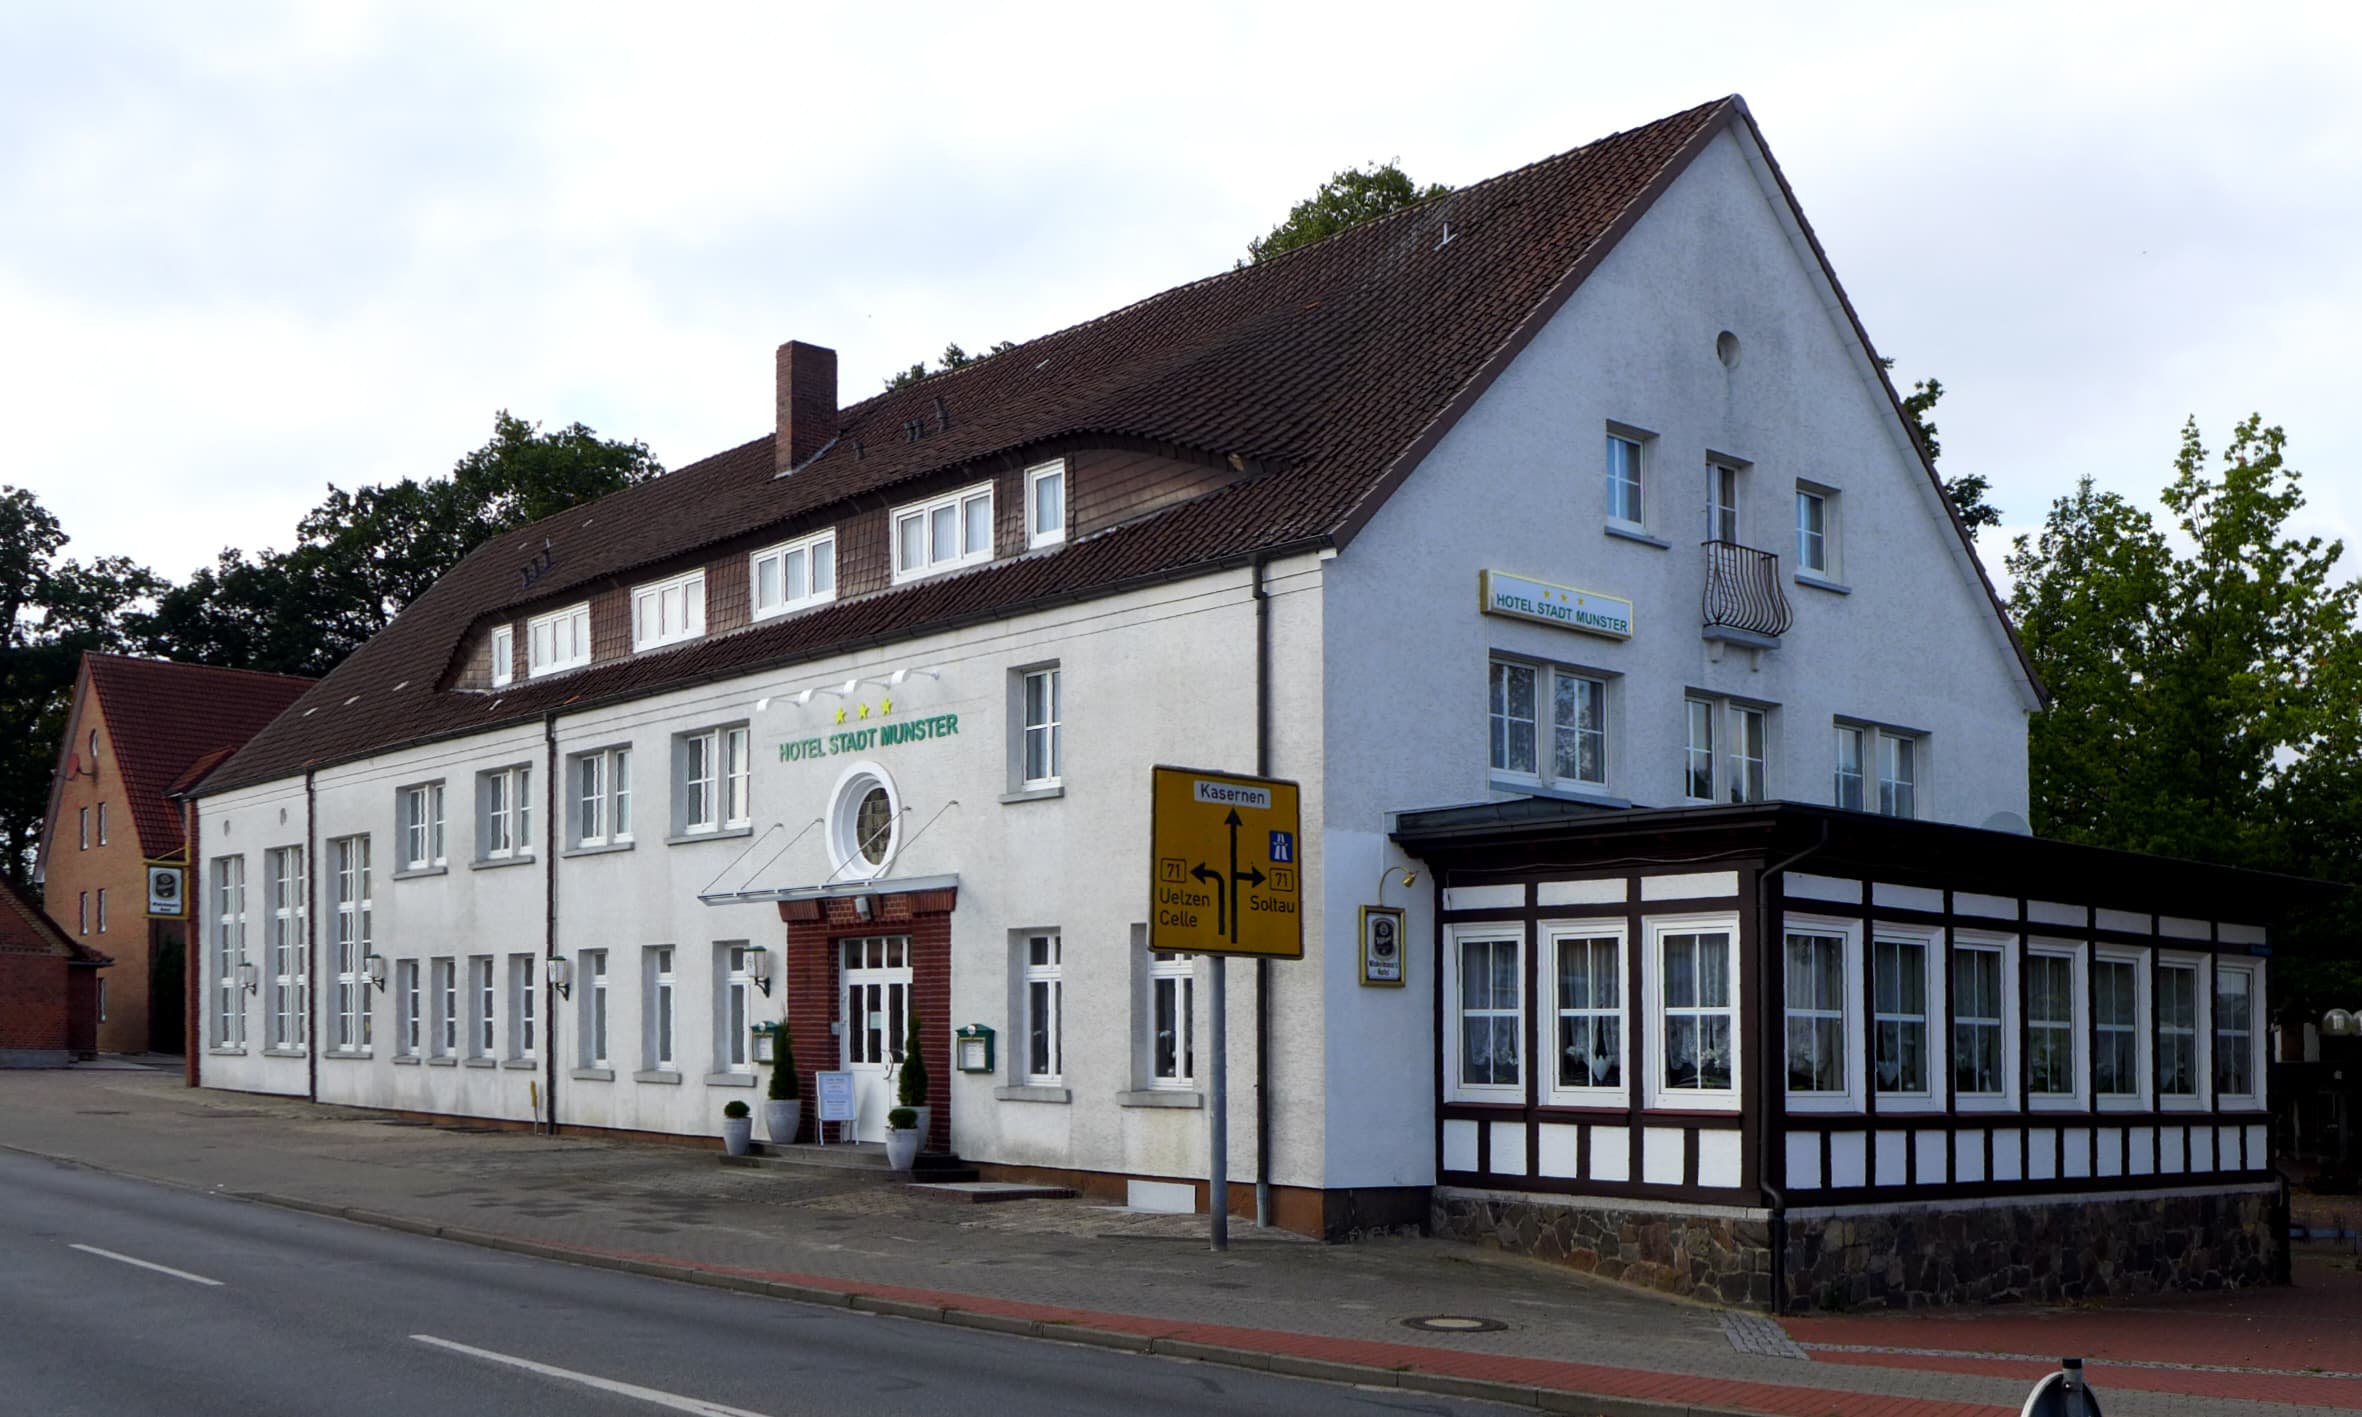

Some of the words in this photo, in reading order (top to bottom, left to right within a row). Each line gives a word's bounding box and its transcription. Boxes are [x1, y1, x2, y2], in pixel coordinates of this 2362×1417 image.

[1496, 593, 1535, 613] HOTEL
[1537, 602, 1573, 621] STADT
[1576, 610, 1628, 633] MUNSTER
[779, 737, 826, 762] HOTEL
[829, 728, 878, 756] STADT
[881, 714, 959, 746] MUNSTER
[1200, 783, 1265, 805] Kasernen
[1166, 863, 1181, 880] 71
[1274, 872, 1289, 888] 71
[1159, 887, 1211, 907] Uelzen
[1249, 895, 1296, 914] Soltau
[1159, 910, 1198, 928] Celle
